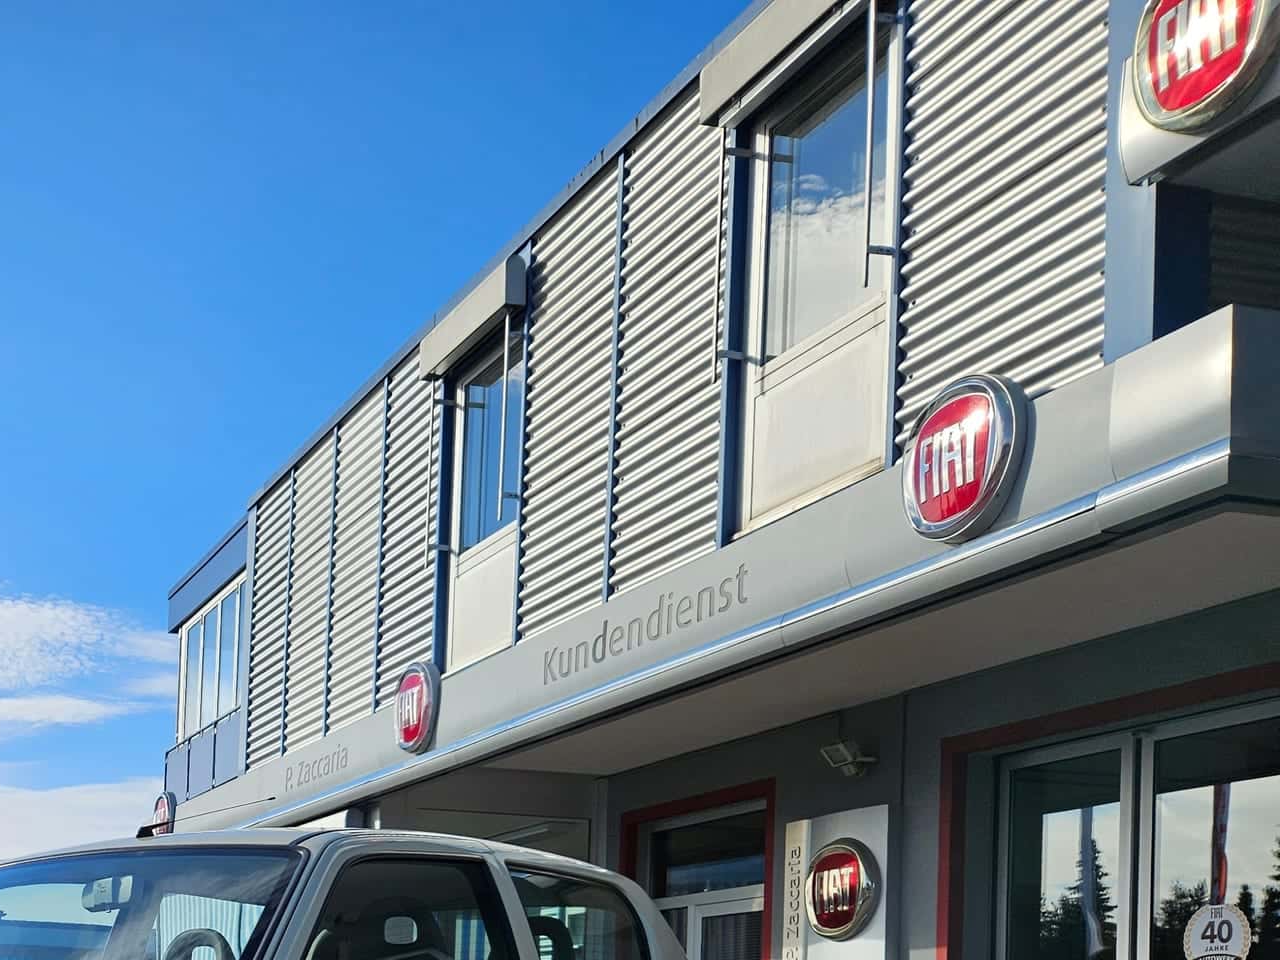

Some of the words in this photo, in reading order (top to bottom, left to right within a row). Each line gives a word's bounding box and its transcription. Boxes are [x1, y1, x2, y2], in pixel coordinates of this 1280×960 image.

[919, 411, 986, 505] FIAT
[543, 562, 749, 686] Kundendienst
[399, 683, 422, 730] FIAT
[284, 766, 294, 793] P.
[296, 743, 349, 787] Zaccaria
[786, 846, 801, 940] Zaccaria
[815, 866, 855, 916] FIAT
[1200, 919, 1233, 944] 40
